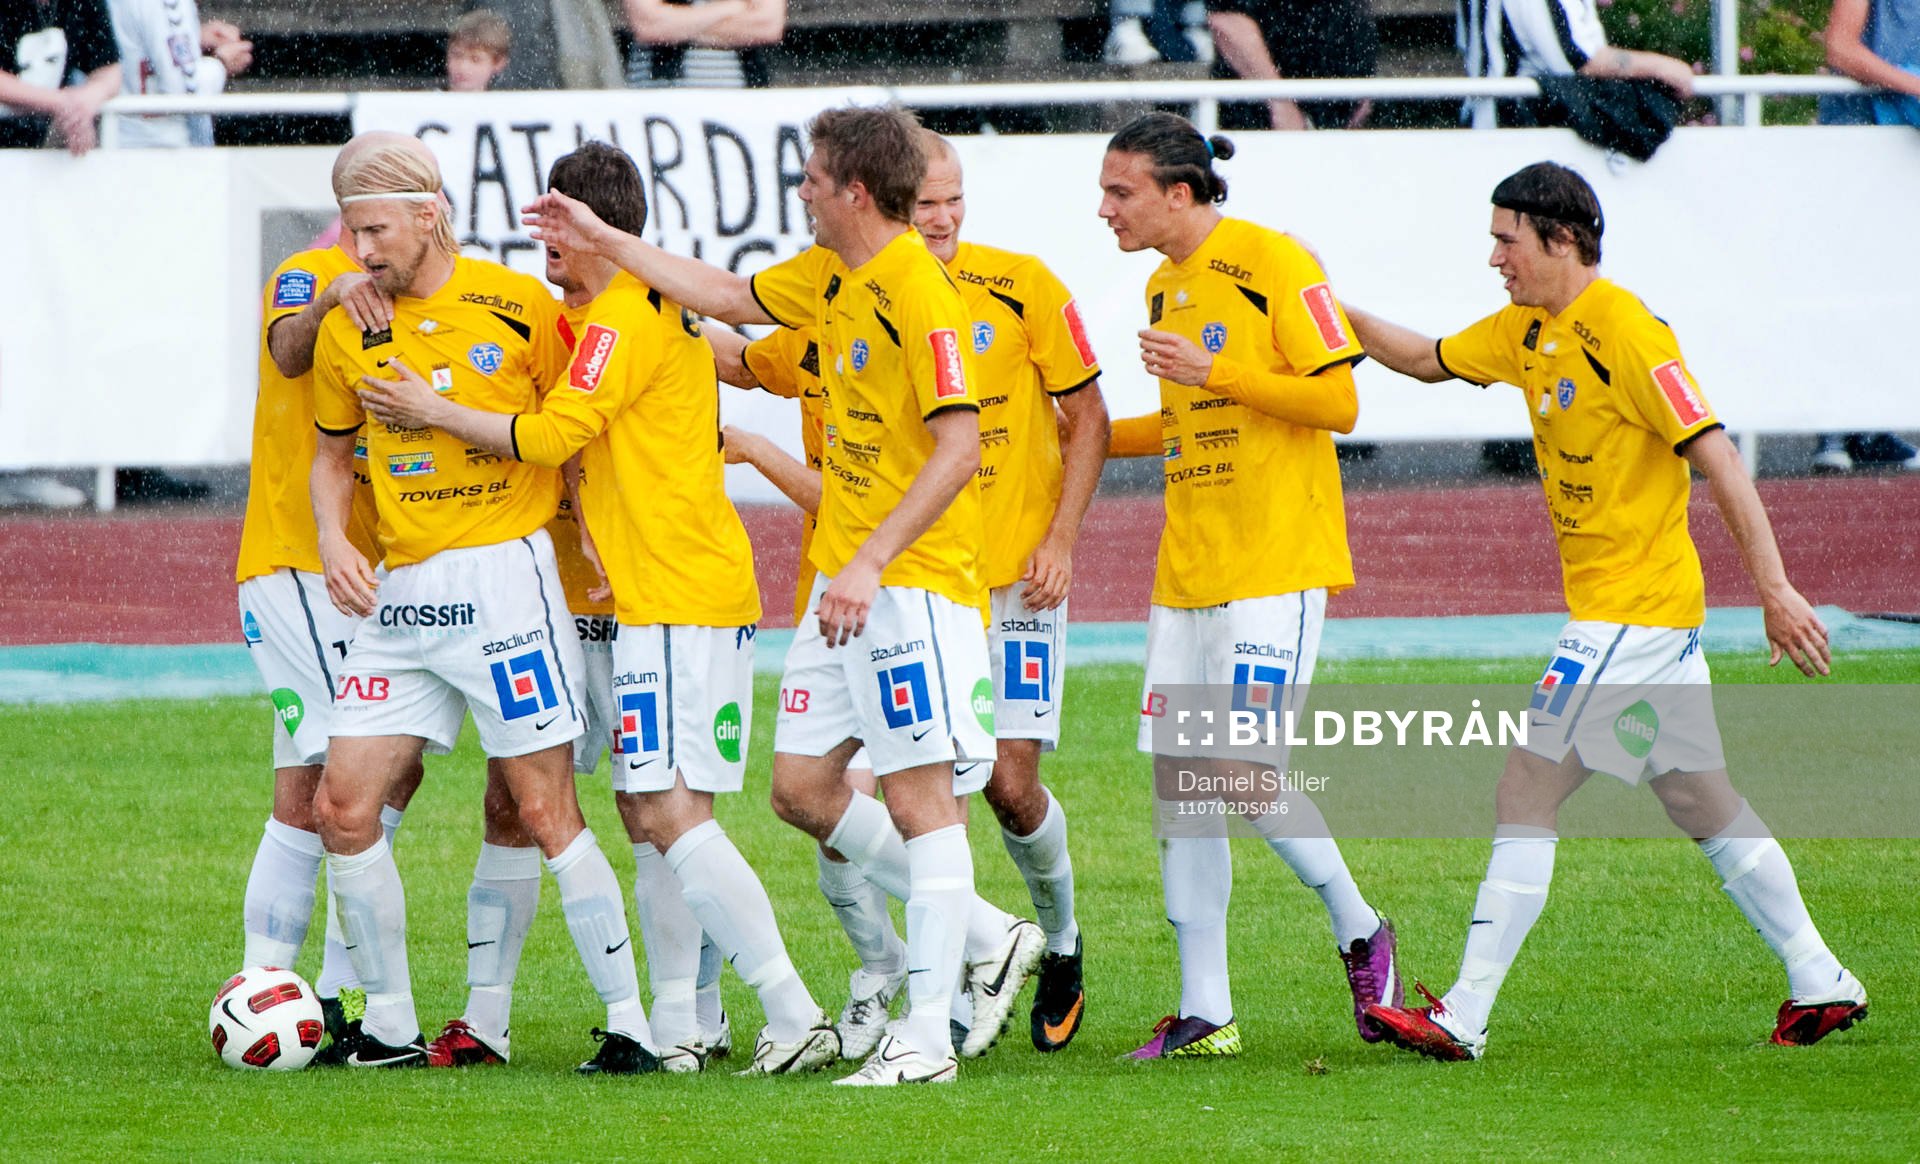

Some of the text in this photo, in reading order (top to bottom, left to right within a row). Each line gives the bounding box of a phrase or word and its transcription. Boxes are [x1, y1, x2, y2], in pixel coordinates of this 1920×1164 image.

[458, 292, 524, 316] stadium
[581, 332, 613, 387] Adecco
[945, 333, 964, 391] Adecco
[401, 431, 433, 443] BERG
[399, 484, 484, 503] TOVEKS
[379, 602, 476, 627] crossfit
[1001, 618, 1051, 634] stadium
[483, 629, 544, 656] stadium
[871, 639, 925, 662] stadium
[1234, 641, 1294, 662] stadium
[1617, 713, 1655, 742] dina
